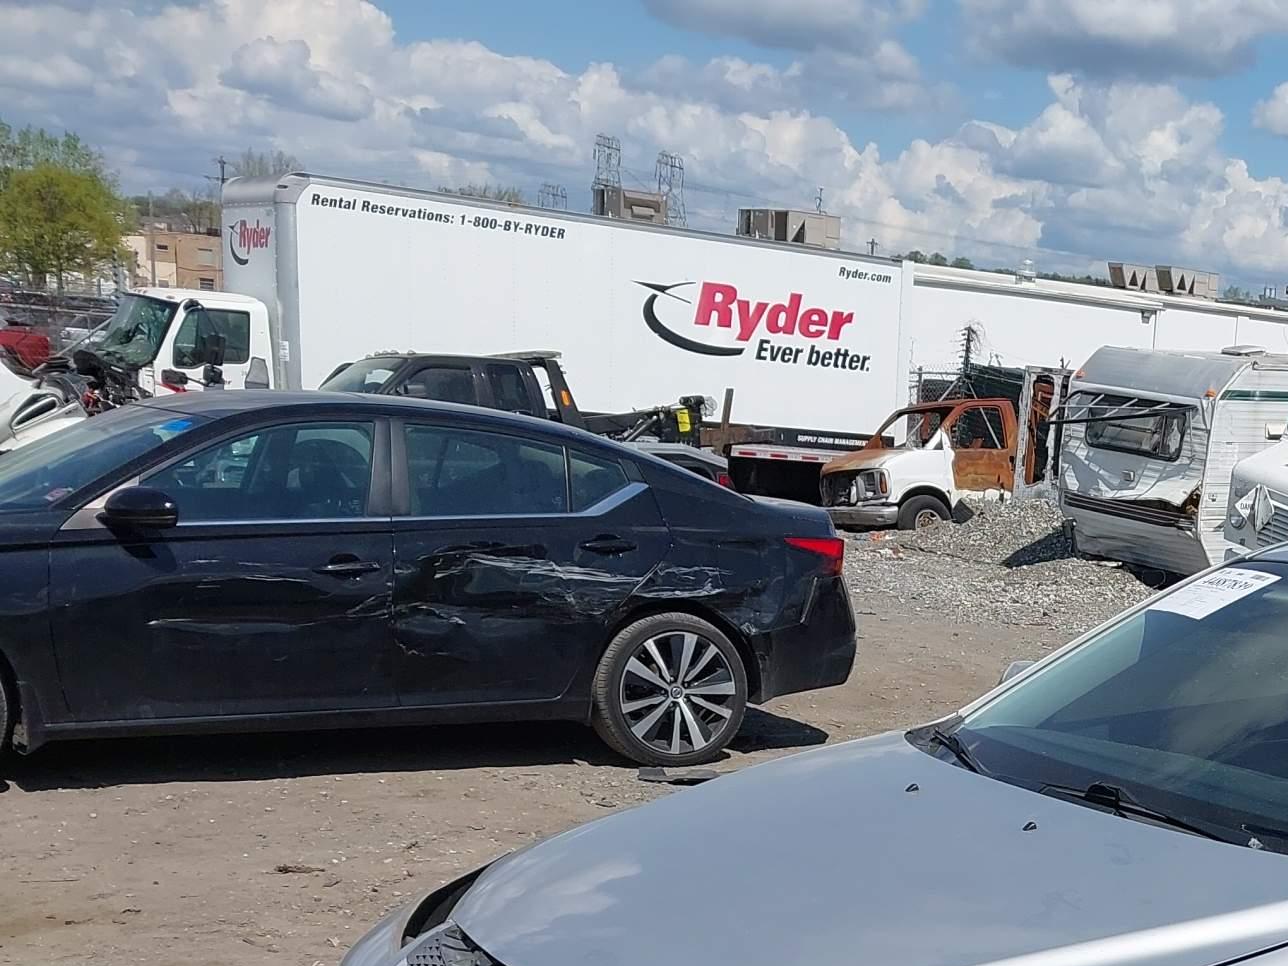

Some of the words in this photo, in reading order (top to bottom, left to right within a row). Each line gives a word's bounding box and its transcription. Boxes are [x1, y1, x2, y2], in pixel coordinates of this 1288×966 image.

[311, 193, 357, 211] Rental
[361, 200, 455, 226] Reservations:
[459, 213, 566, 240] 1-800-BY-RYDER
[238, 218, 272, 256] Ryder
[838, 266, 892, 284] Ryder.com
[694, 282, 855, 342] Ryder
[755, 338, 804, 364] Ever
[806, 347, 871, 372] better.
[797, 434, 817, 443] SUPPLY
[817, 436, 834, 444] CHAIN
